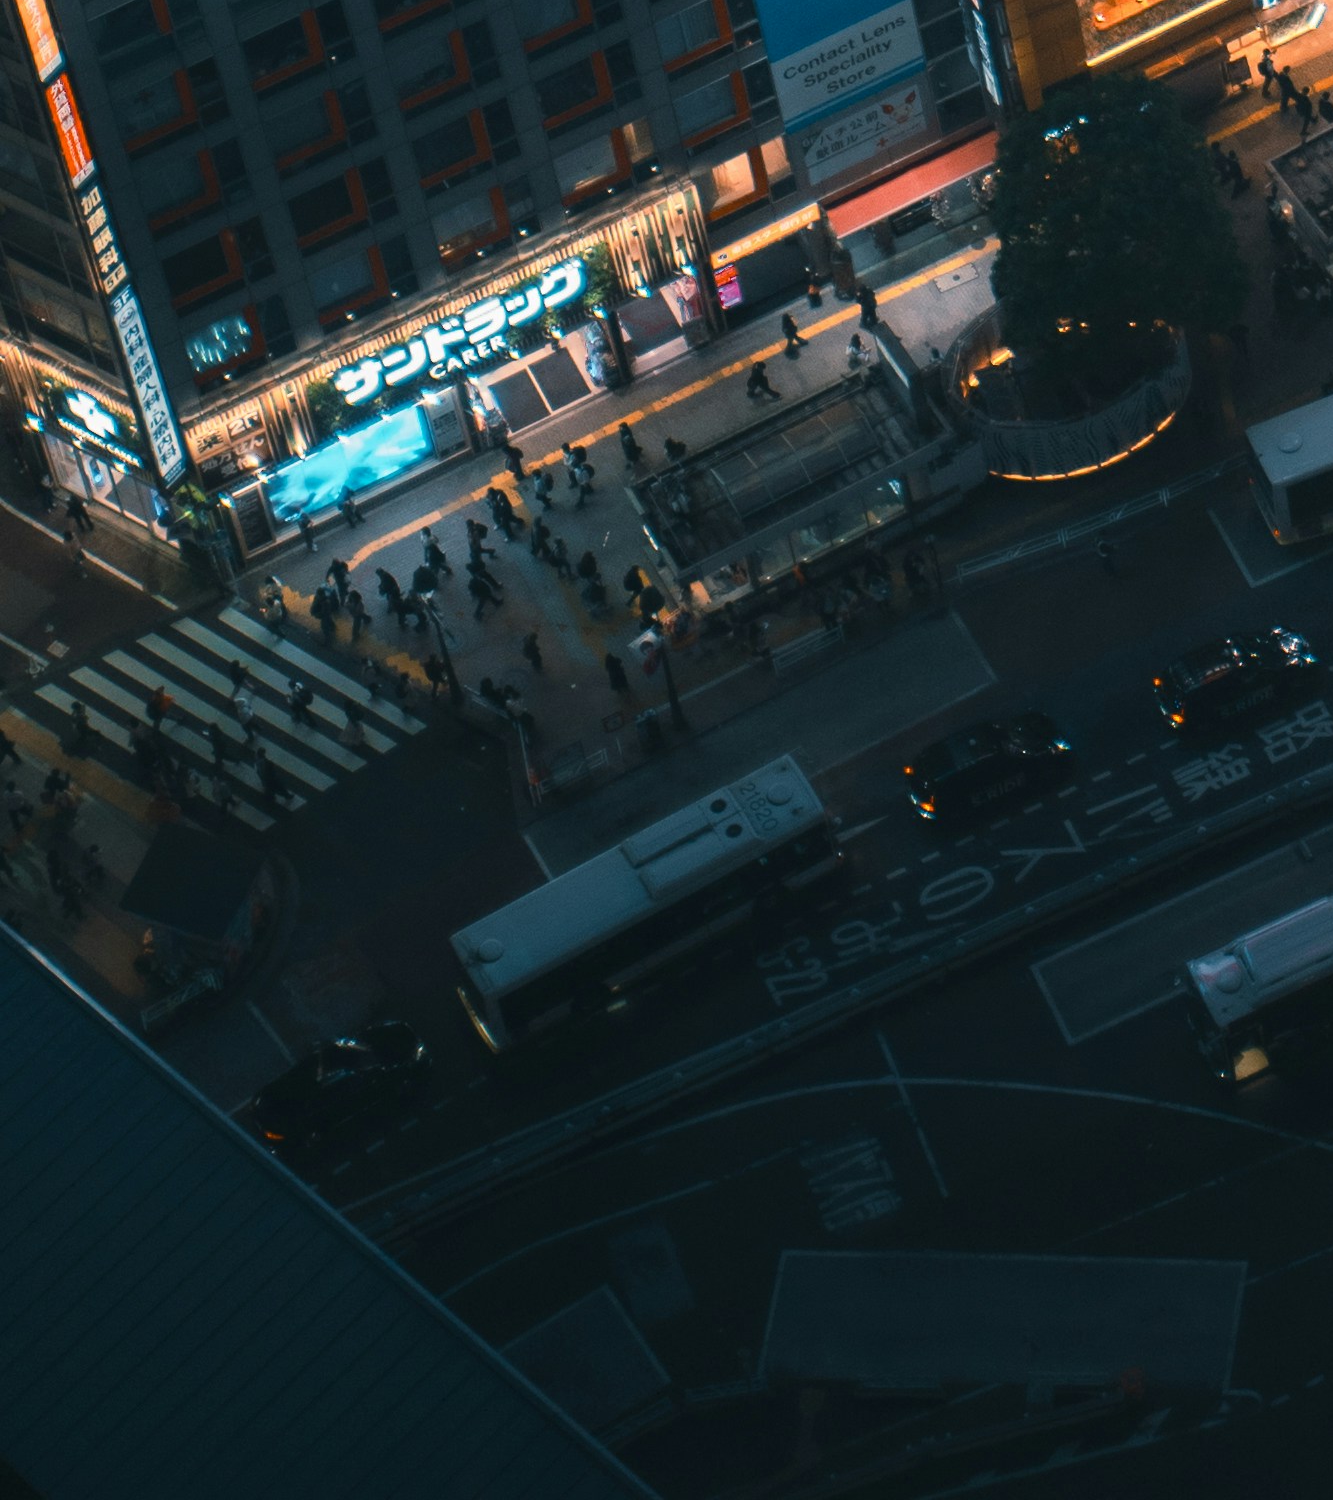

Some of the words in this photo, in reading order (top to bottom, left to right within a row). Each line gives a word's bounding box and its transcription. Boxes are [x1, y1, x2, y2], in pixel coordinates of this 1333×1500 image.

[783, 40, 856, 81] Contact
[860, 15, 907, 46] Lens
[804, 38, 892, 89] Speciality
[826, 64, 877, 95] Store
[819, 109, 880, 145] ハチ公前
[106, 267, 124, 289] 5F
[113, 289, 130, 312] 3F
[124, 324, 145, 357] 内科
[333, 258, 589, 404] サンドラッグ
[427, 336, 509, 381] CARER
[196, 429, 224, 453] 薬
[229, 411, 259, 437] 2F
[738, 780, 779, 831] 21820
